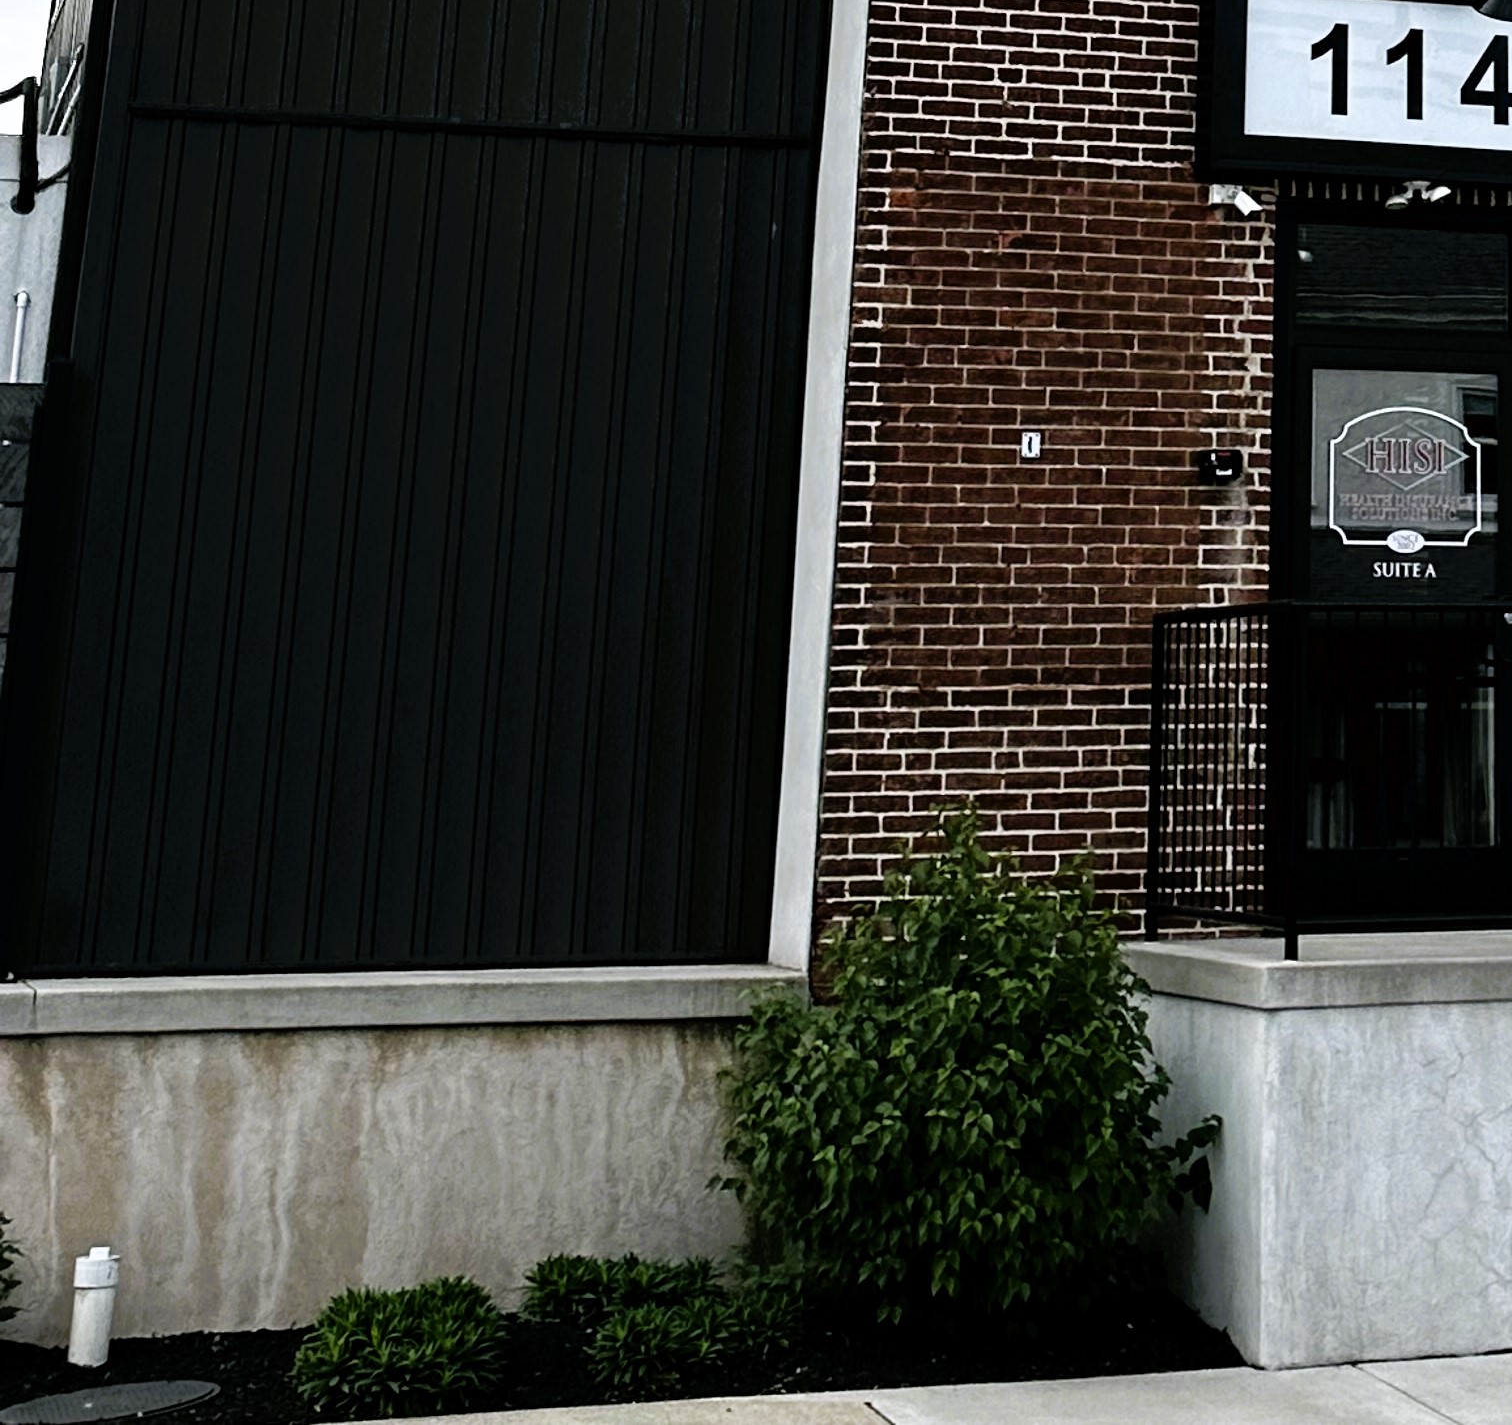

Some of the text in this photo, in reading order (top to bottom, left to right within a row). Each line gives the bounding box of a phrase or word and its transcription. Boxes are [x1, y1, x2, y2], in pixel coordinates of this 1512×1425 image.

[1365, 437, 1447, 474] HISI
[1373, 561, 1437, 578] SUITE A
